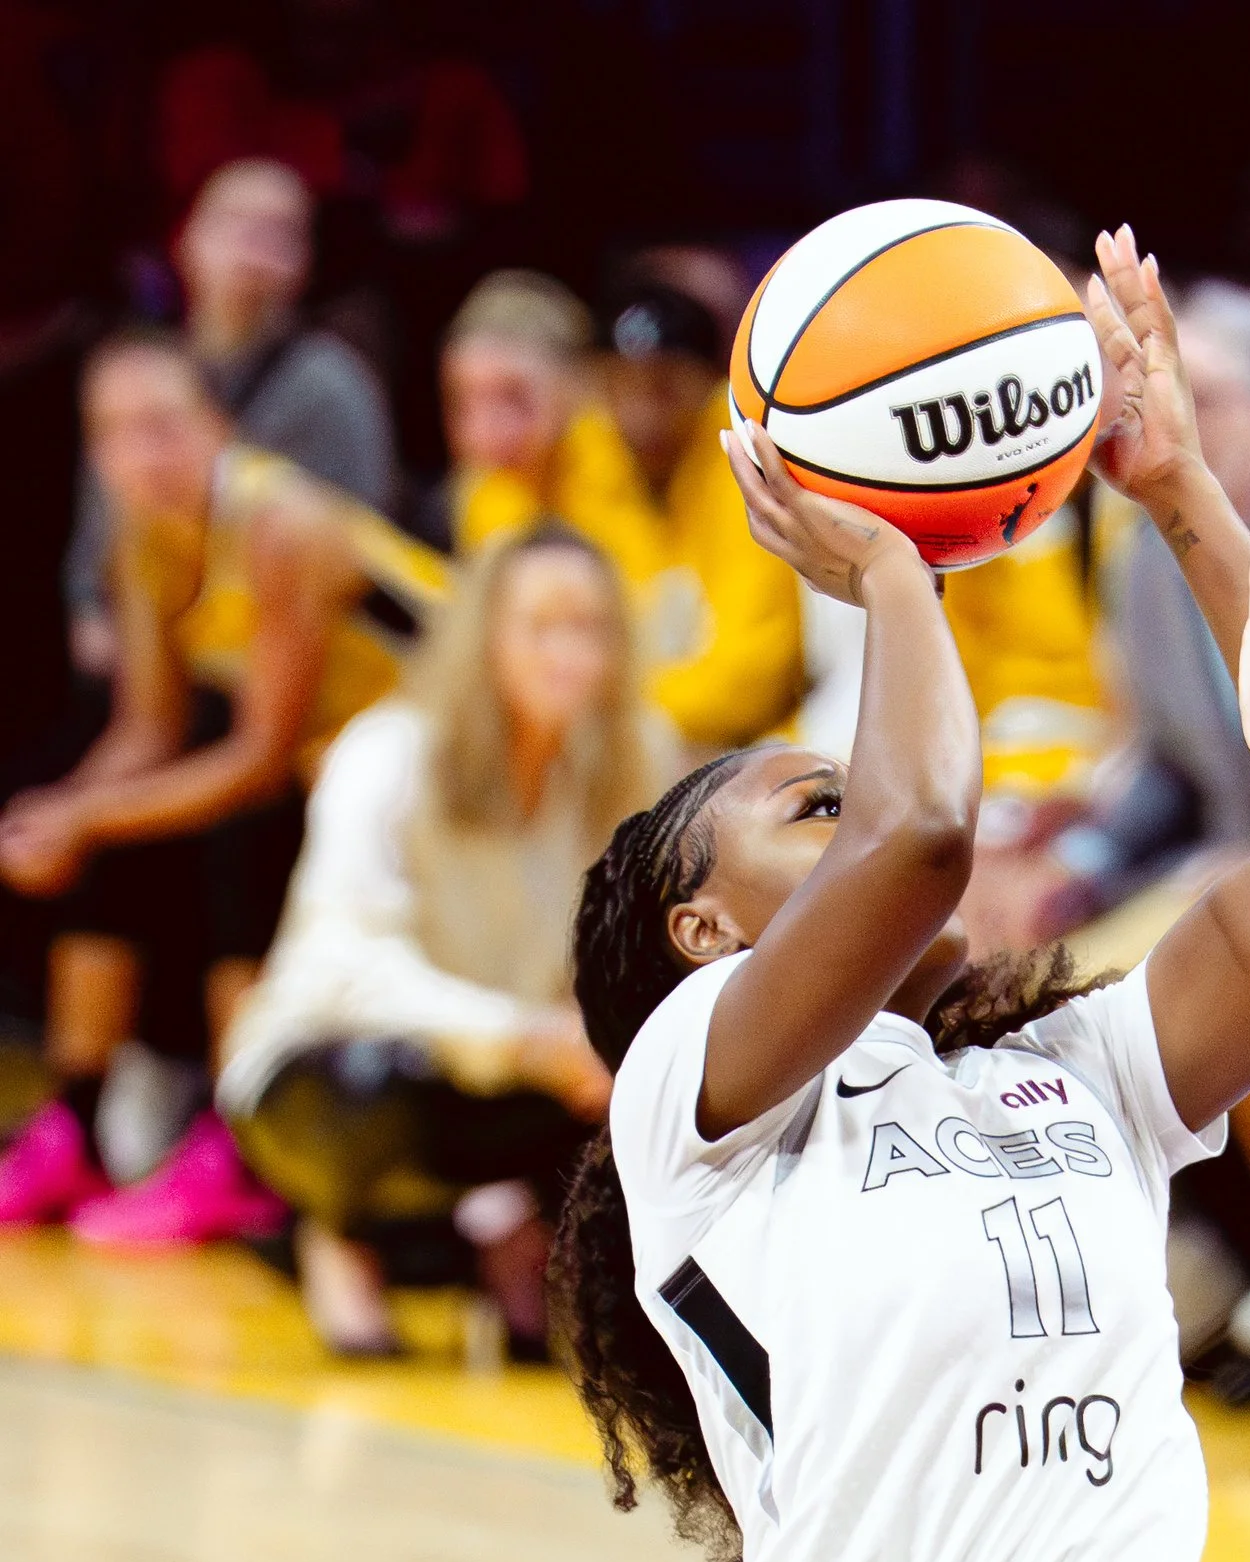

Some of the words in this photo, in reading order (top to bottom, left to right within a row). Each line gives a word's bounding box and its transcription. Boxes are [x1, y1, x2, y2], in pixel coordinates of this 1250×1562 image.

[889, 360, 1096, 464] Wilson
[999, 1077, 1070, 1110] ally
[861, 1115, 1113, 1192] ACES
[981, 1195, 1101, 1339] 11
[974, 1378, 1121, 1487] ring
